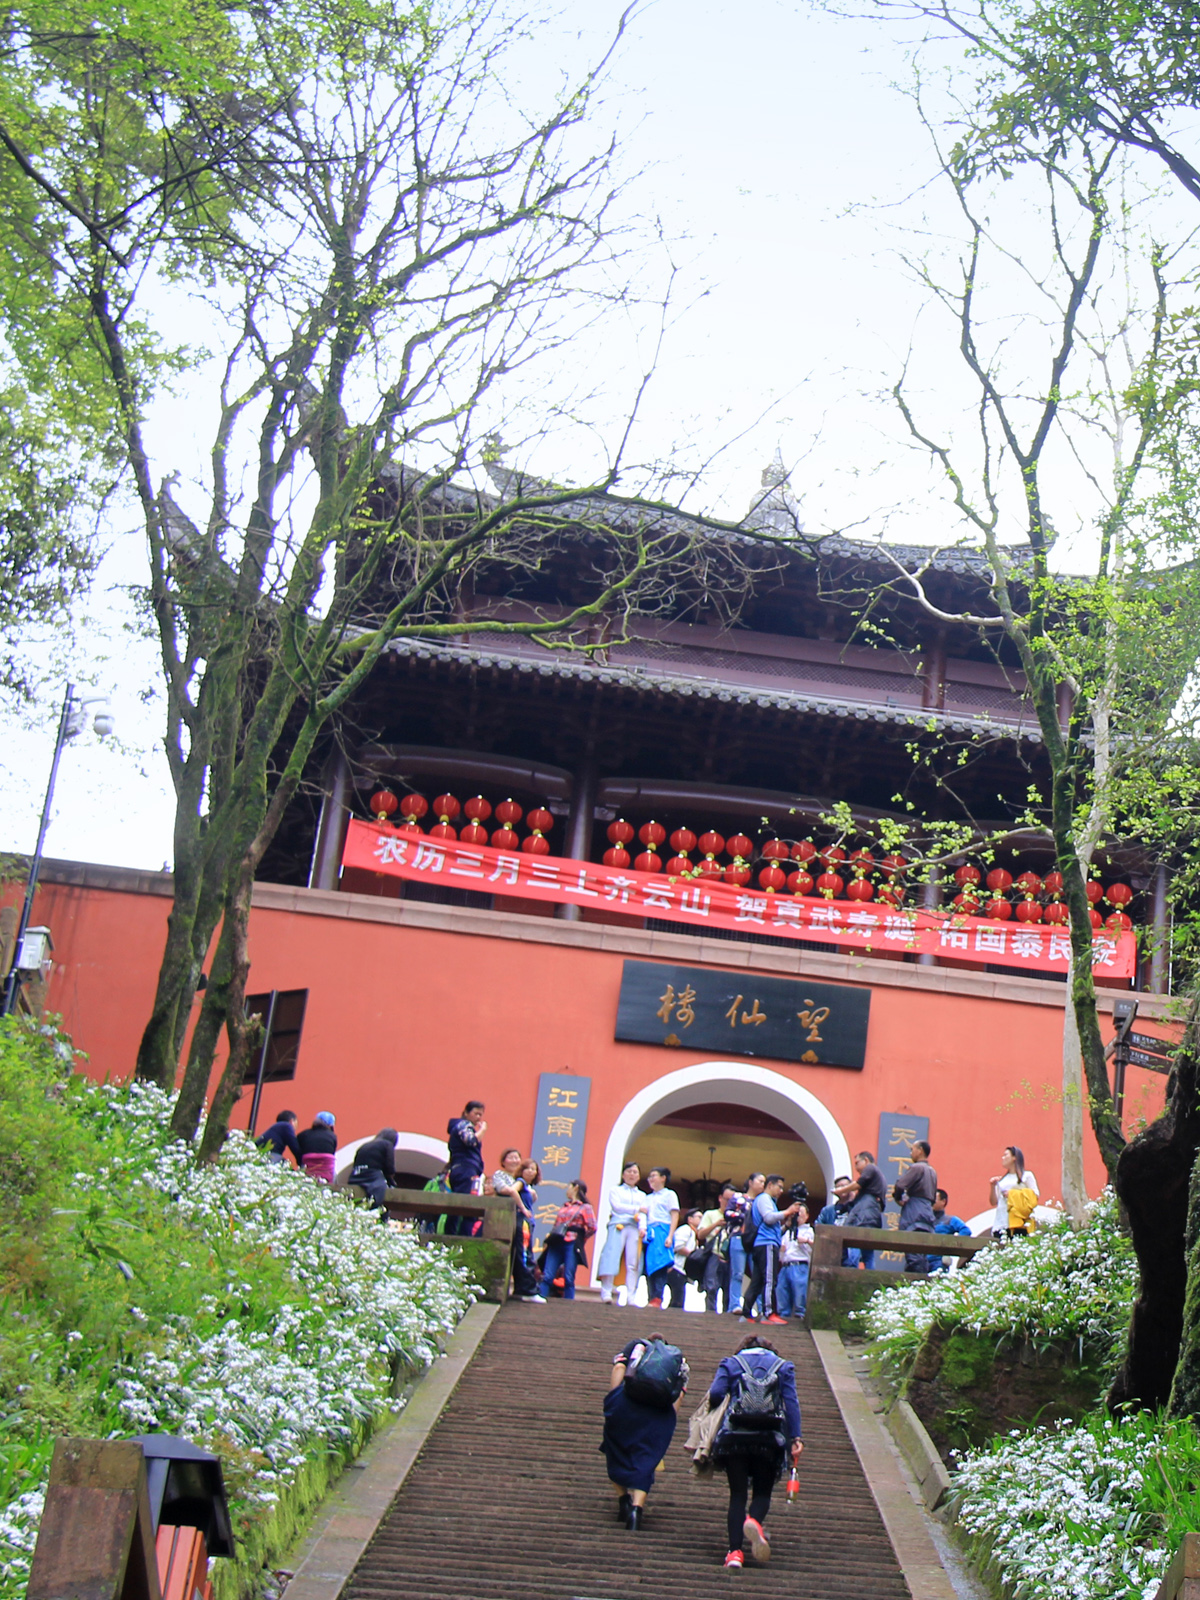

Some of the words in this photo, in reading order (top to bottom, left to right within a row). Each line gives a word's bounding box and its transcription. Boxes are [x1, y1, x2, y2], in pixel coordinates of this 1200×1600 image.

[373, 835, 711, 917] 农历三月三上齐云山
